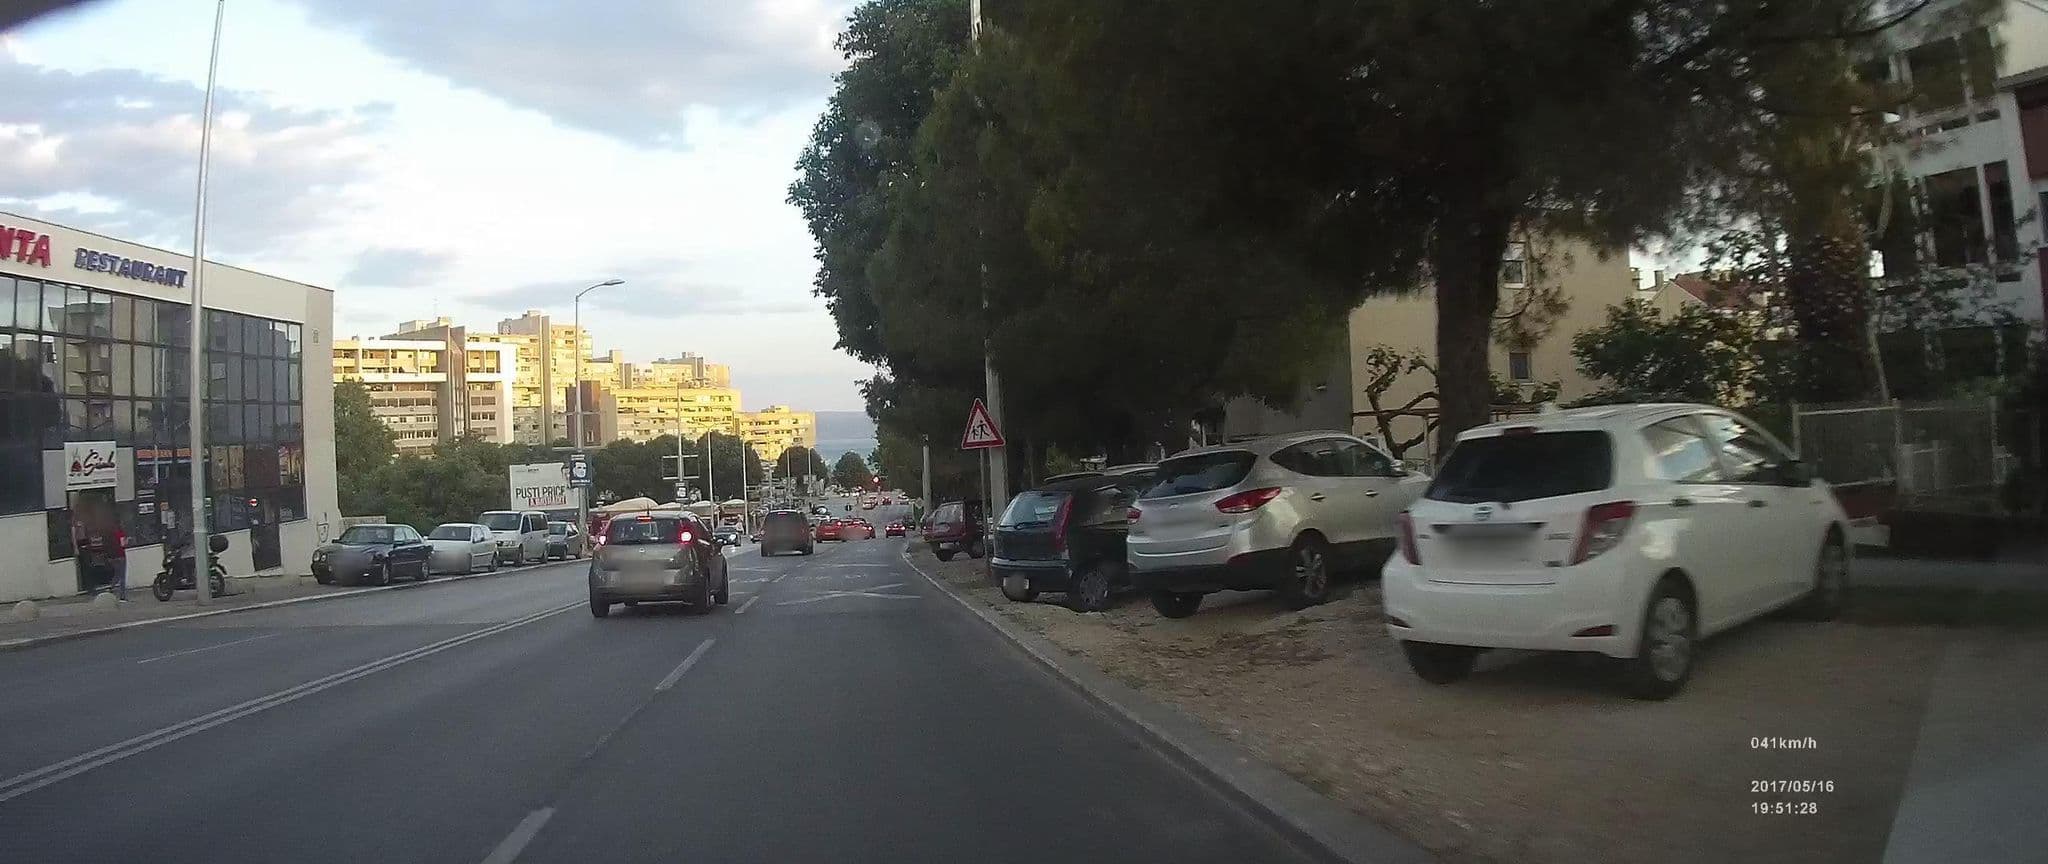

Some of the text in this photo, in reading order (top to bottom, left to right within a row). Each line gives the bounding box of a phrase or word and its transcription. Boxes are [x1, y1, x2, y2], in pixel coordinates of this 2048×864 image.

[74, 247, 187, 288] RESTAURANT
[515, 485, 566, 499] PUSTI PRICE
